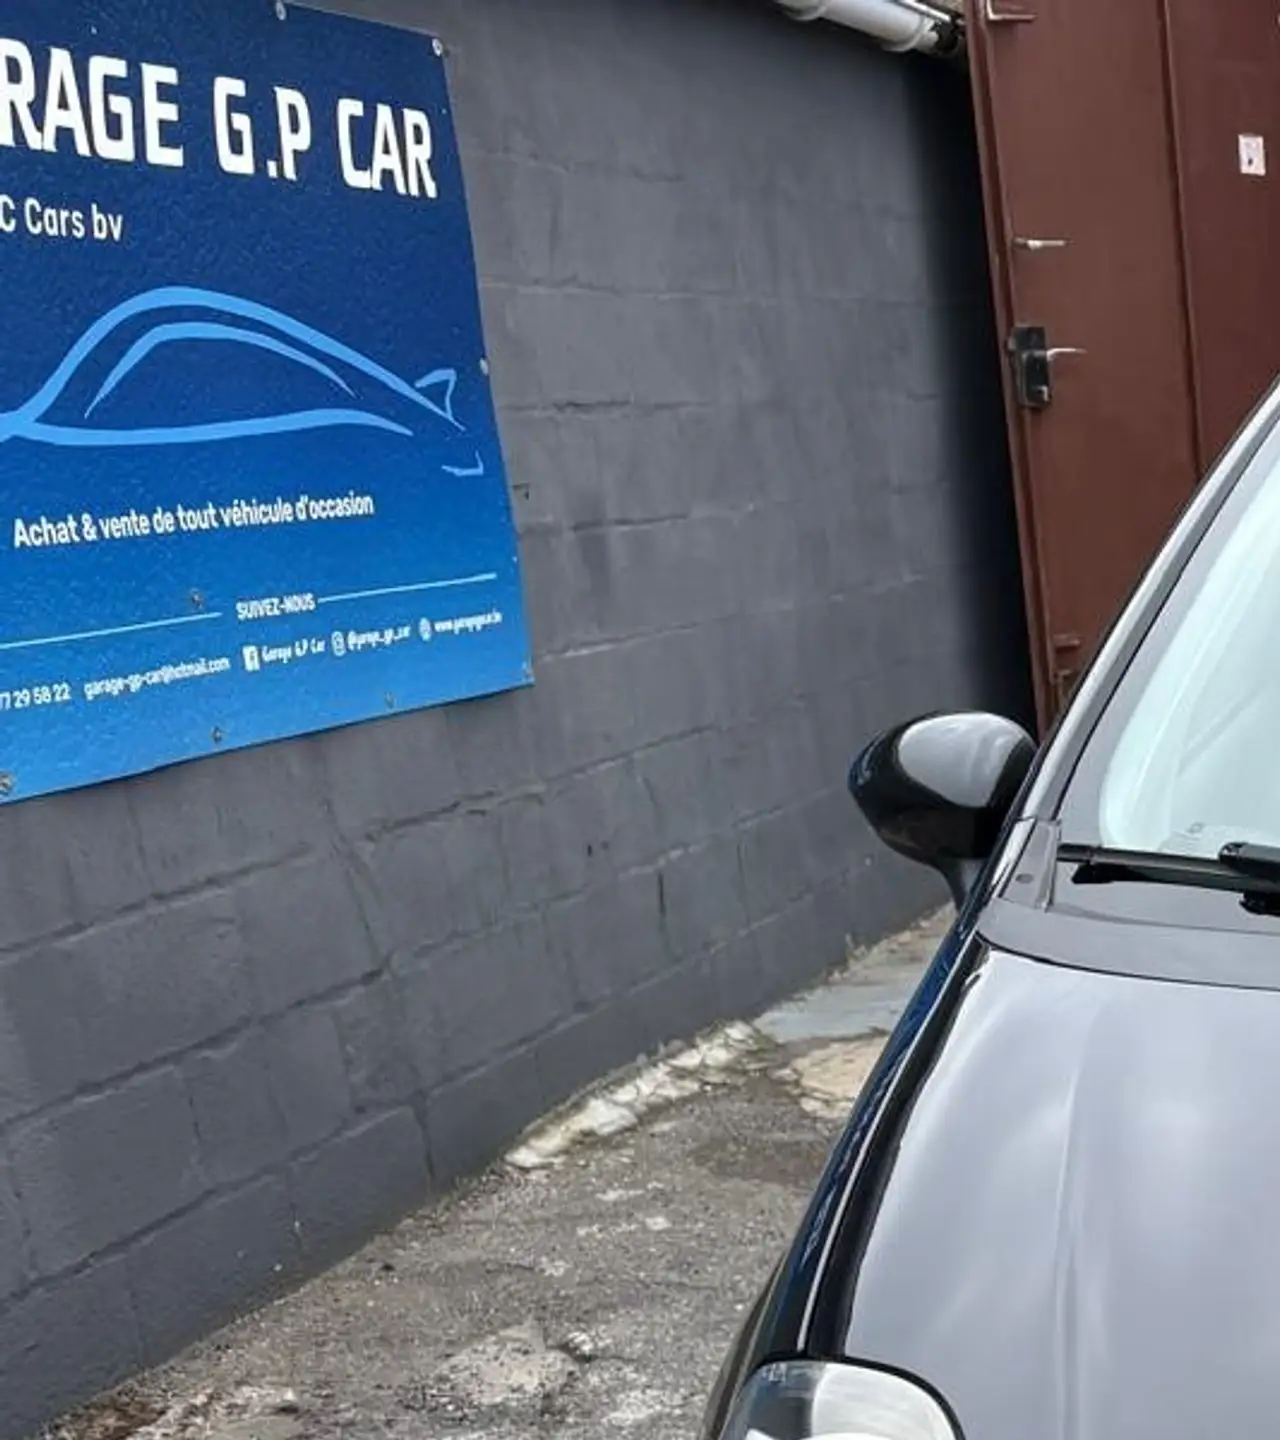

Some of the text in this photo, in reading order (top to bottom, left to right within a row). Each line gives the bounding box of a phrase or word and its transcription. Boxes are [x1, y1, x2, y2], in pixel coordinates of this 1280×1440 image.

[213, 76, 311, 181] G.P
[337, 98, 437, 199] CAR
[24, 197, 85, 239] Cars
[91, 203, 123, 242] bv
[13, 514, 80, 548] Achat
[81, 512, 97, 541] &
[99, 508, 150, 539] vente
[153, 504, 175, 533] de
[177, 502, 220, 531] tout
[221, 496, 293, 527] véhicule
[236, 593, 316, 621] SUIVEZ-NOUS
[13, 688, 30, 709] 29
[52, 681, 72, 702] 22
